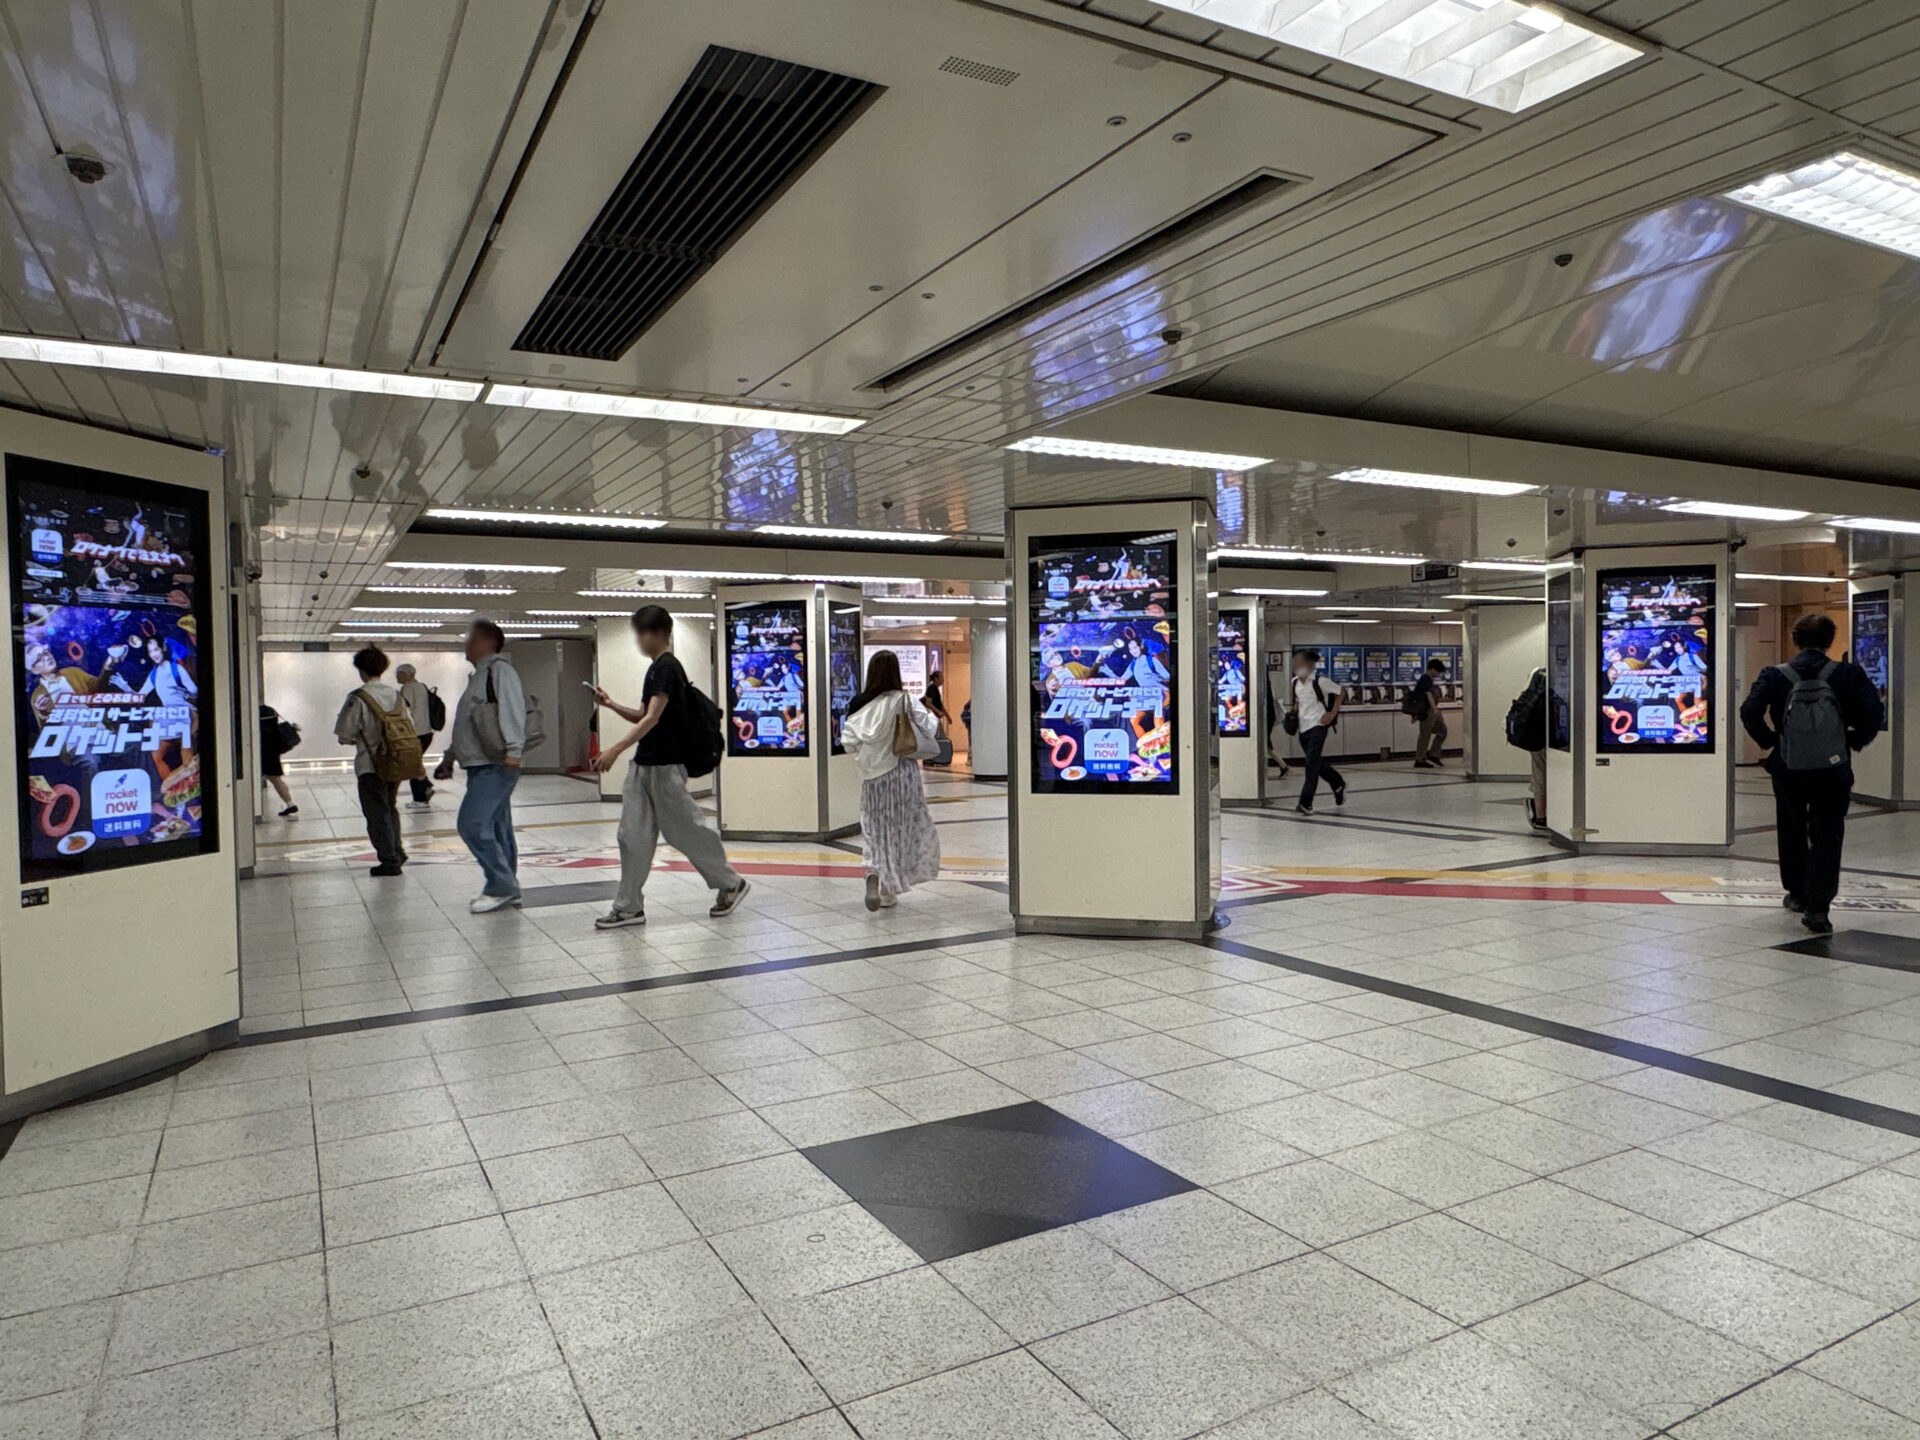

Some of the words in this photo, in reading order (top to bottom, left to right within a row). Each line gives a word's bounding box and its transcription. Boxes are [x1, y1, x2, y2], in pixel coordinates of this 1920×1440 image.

[1605, 683, 1701, 699] ロケットナウ
[1044, 697, 1163, 718] ロケットナウ
[29, 720, 192, 758] ロケットナウ
[1094, 750, 1119, 758] now
[105, 789, 138, 800] rocket
[105, 801, 138, 814] now
